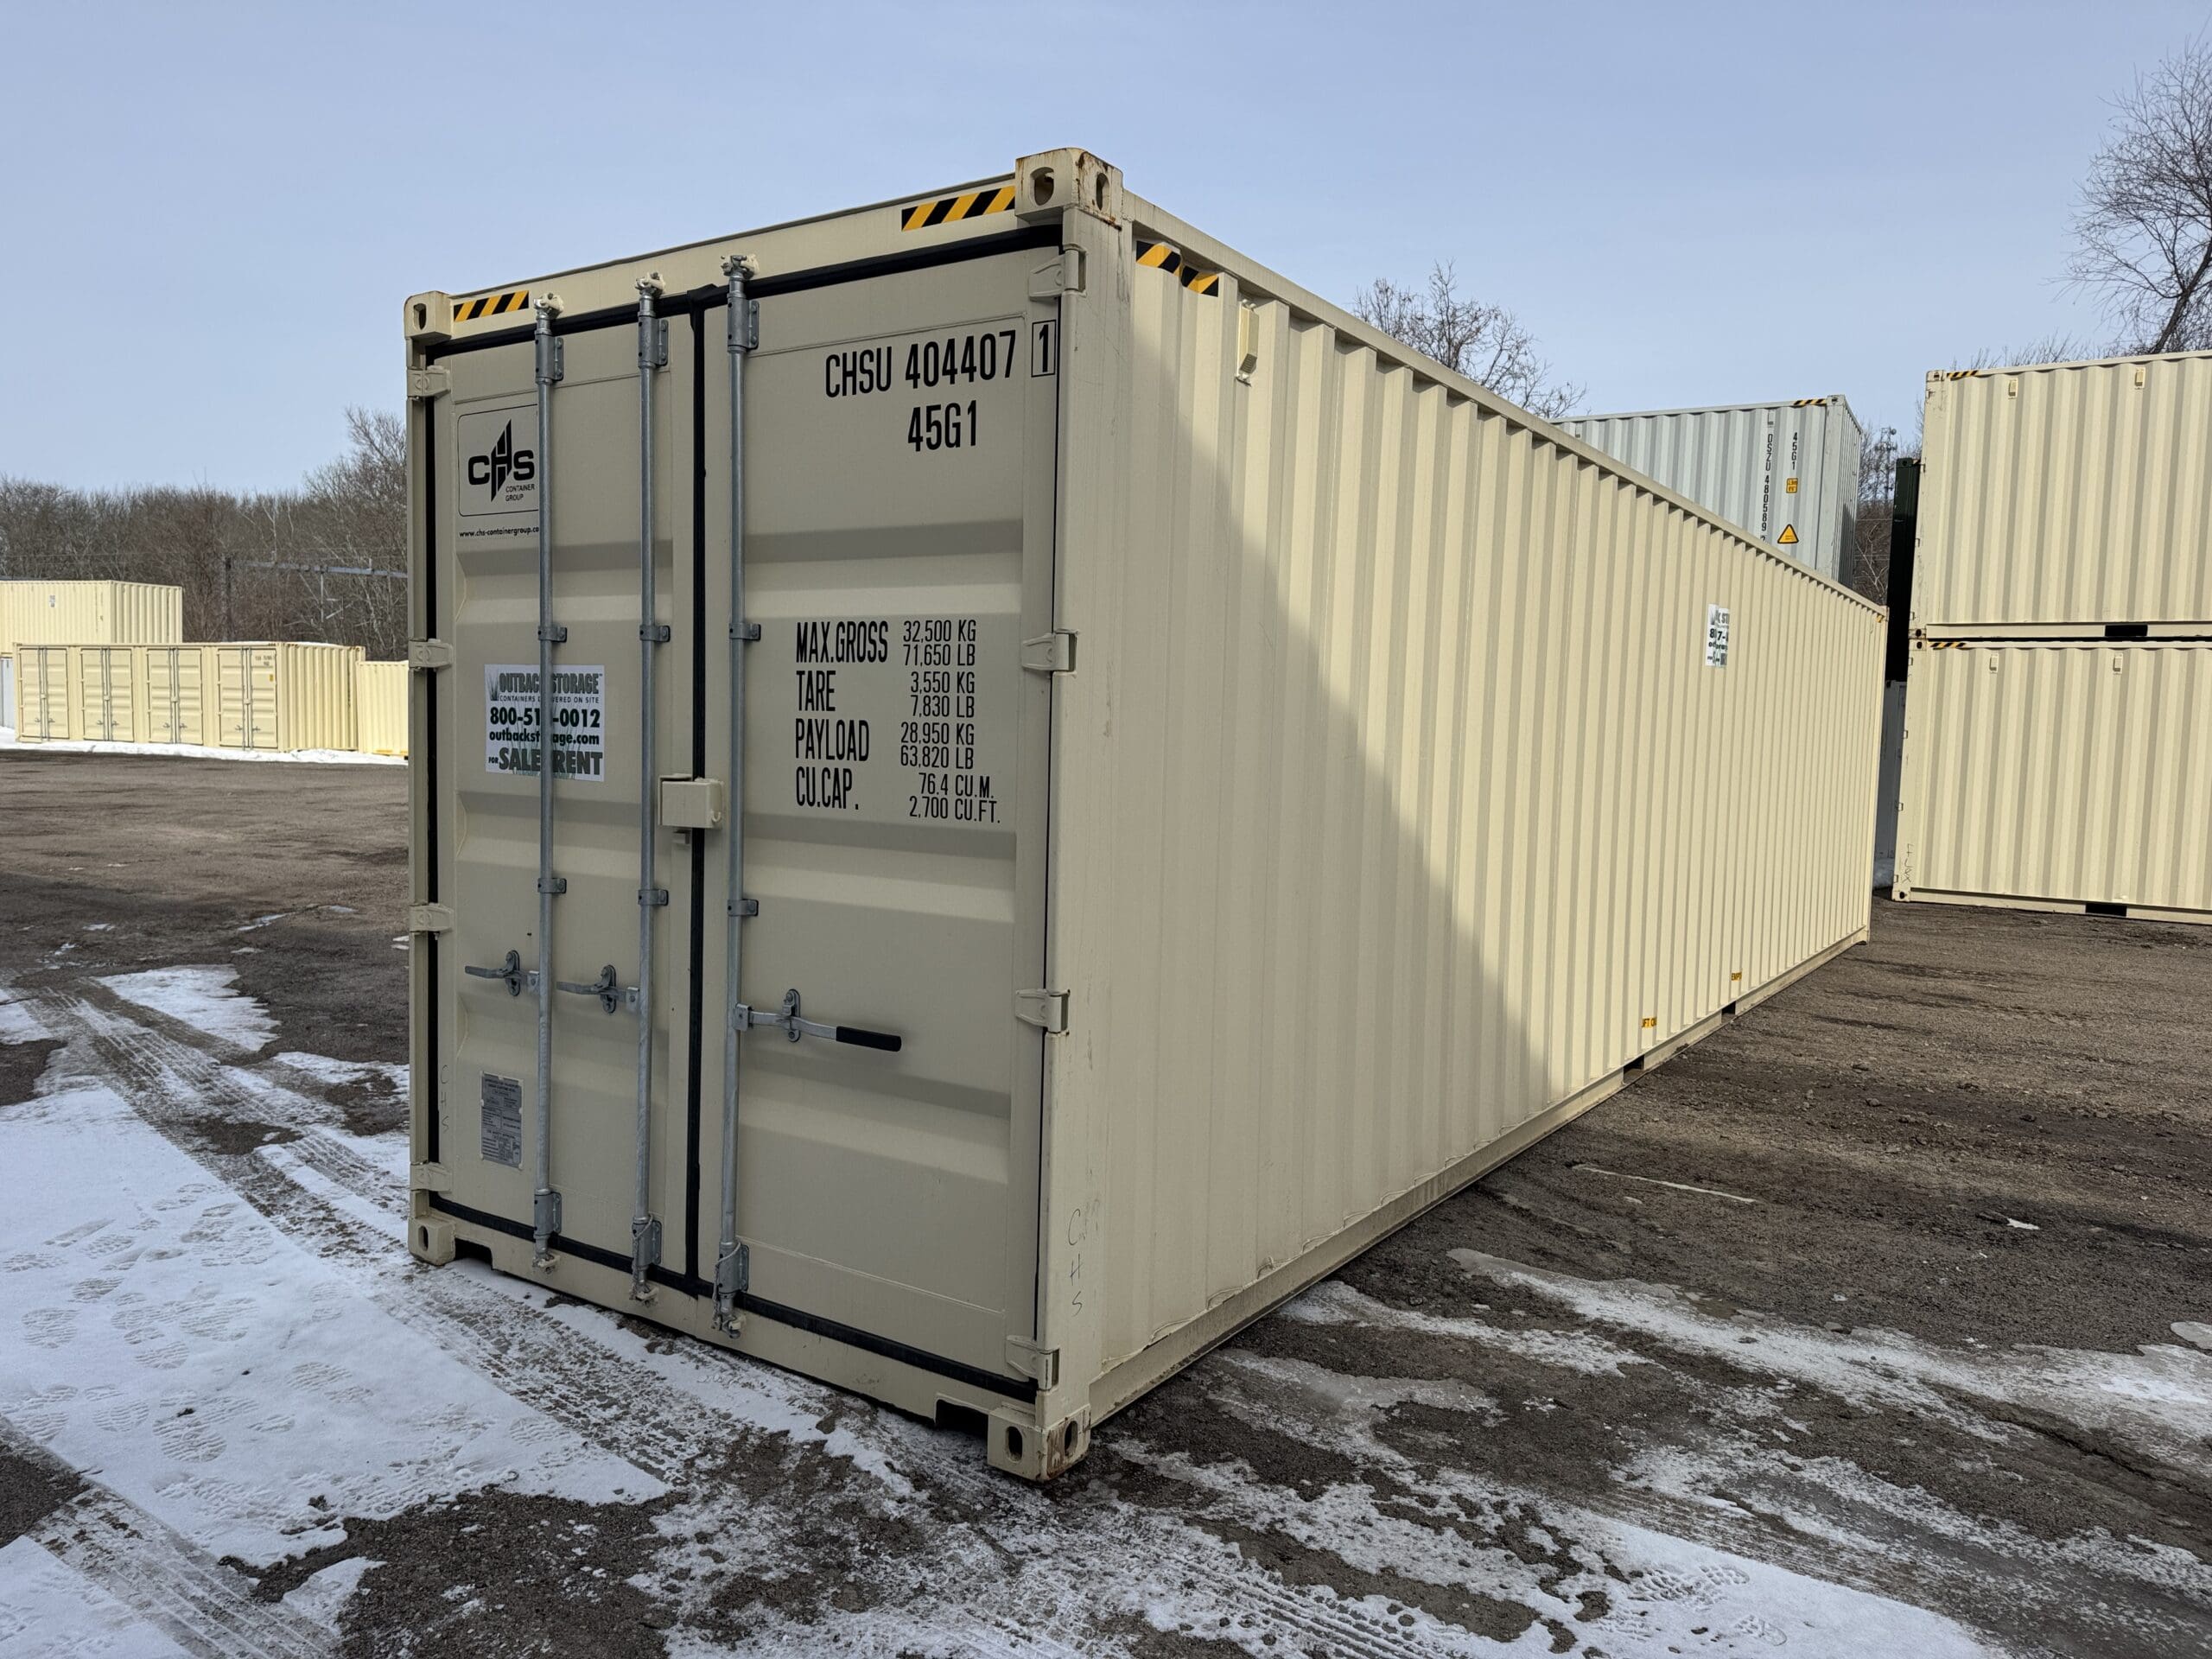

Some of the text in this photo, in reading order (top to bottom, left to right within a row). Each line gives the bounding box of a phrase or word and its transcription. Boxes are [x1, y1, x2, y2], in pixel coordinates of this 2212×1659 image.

[825, 324, 1049, 397] CHSU 404407 1
[908, 399, 977, 452] 45G1
[505, 483, 535, 493] CONTAINER
[505, 493, 524, 502] GROUP
[1761, 474, 1770, 531] 480589
[459, 525, 540, 537] www.chs-containergroup.co
[796, 619, 976, 664] MAX.GROSS 32,500 KG
[903, 644, 976, 667] 71,650 LB
[499, 672, 541, 694] OUTBAC
[796, 670, 976, 712] TARE 3,550 KG
[490, 707, 601, 728] 800-51-0012
[910, 695, 975, 718] 7,830 LB
[489, 727, 600, 747] outbackstage.com
[795, 718, 975, 762] PAYLOAD 28,950 KG
[499, 747, 541, 772] SALE
[551, 750, 603, 775] RENT
[900, 745, 974, 770] 63,820 LB
[918, 772, 949, 795] 76.4
[955, 774, 995, 798] CU.M.
[909, 796, 1001, 823] 2,700 CU.FT.
